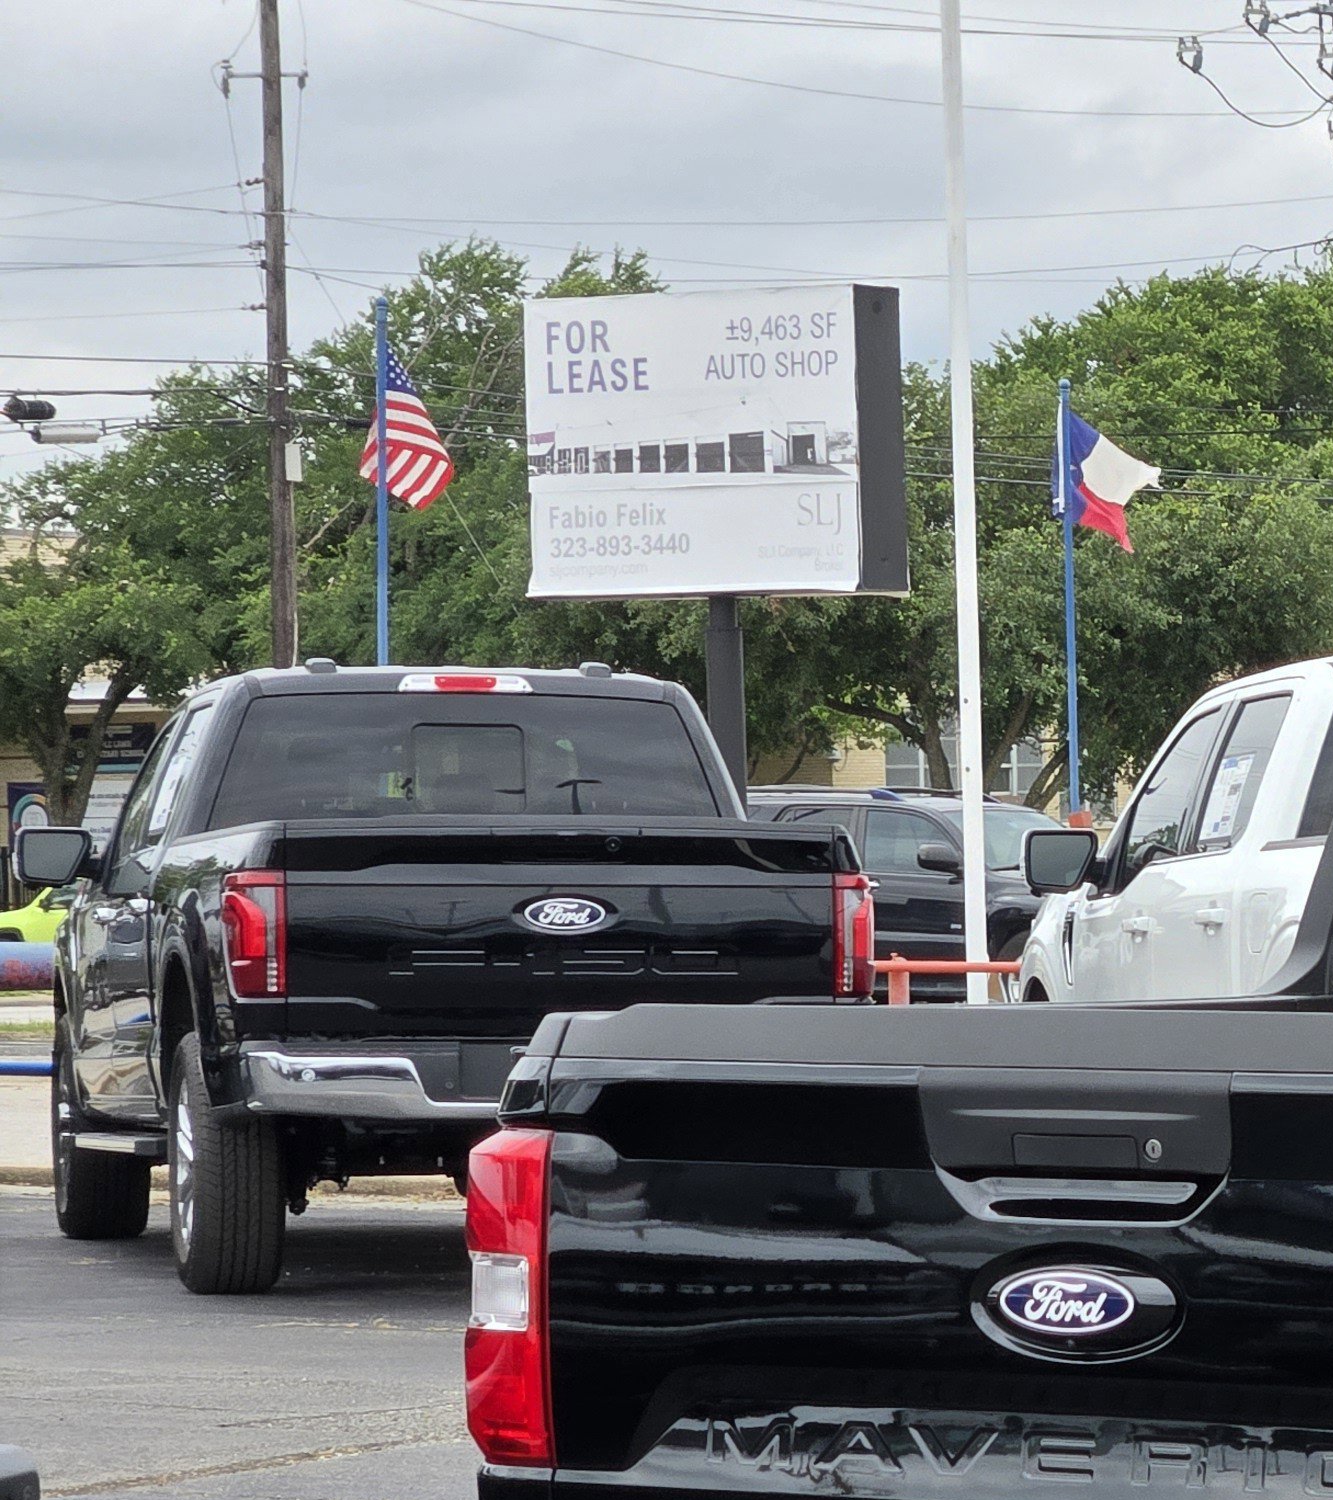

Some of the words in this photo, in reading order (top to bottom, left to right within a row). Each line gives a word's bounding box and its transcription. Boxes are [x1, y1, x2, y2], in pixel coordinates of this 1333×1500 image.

[546, 319, 611, 355] FOR
[725, 314, 802, 346] ±9,463
[810, 312, 838, 339] SF
[547, 356, 650, 395] LEASE
[704, 353, 767, 381] AUTO
[774, 349, 839, 378] SHOP
[549, 505, 608, 530] Fabio
[616, 503, 667, 528] Felix
[796, 493, 842, 535] SLJ
[550, 533, 691, 559] 323-893-3440
[538, 902, 590, 925] Ford
[388, 945, 740, 976] F-150
[1023, 1279, 1107, 1325] Ford
